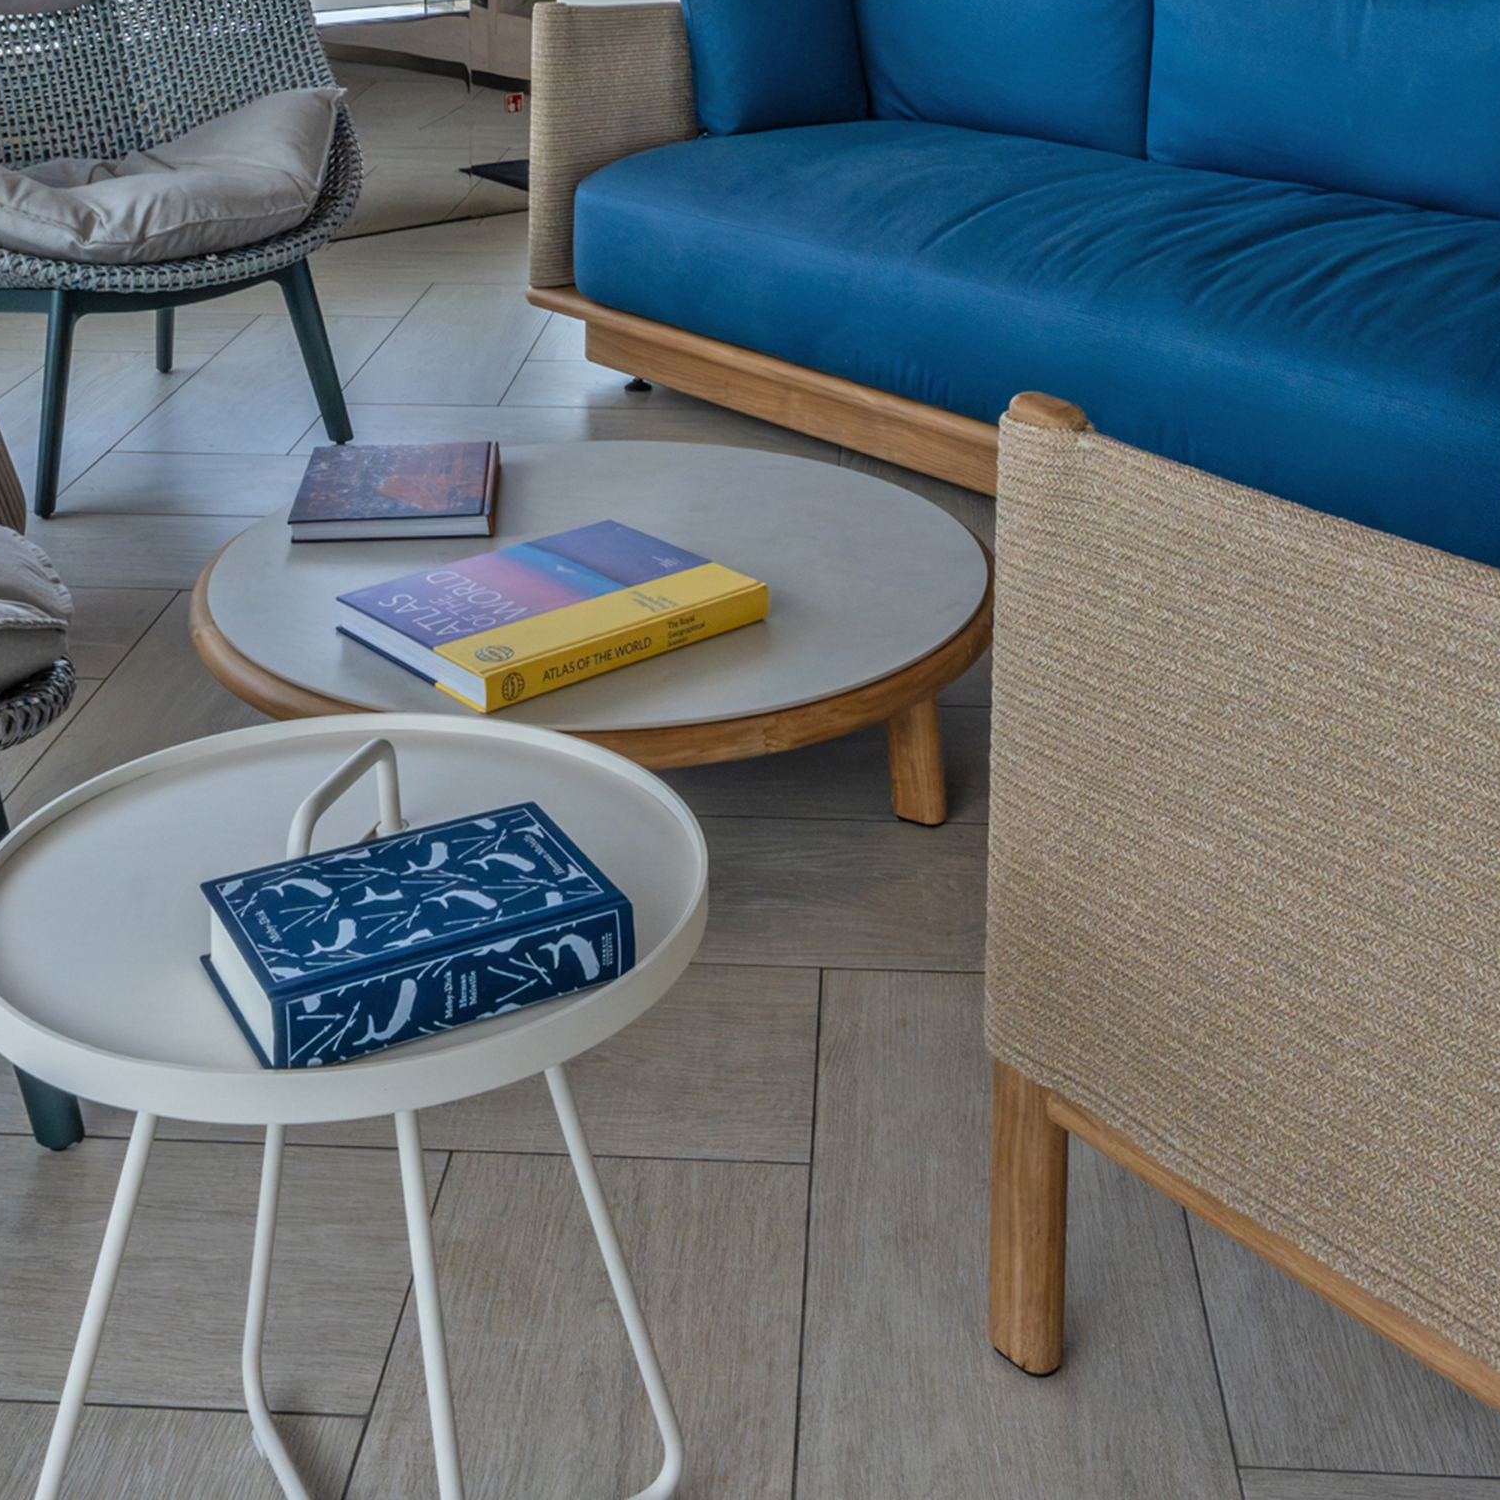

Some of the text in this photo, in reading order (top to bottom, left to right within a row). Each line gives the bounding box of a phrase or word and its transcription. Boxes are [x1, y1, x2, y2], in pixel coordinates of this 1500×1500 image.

[426, 570, 527, 621] WORLD
[428, 594, 496, 628] OF THE
[378, 594, 475, 636] ATLAS
[667, 614, 696, 629] The Royal
[542, 636, 652, 683] ATLAS OF THE WORLD
[254, 909, 282, 943] Moby-Dick
[443, 970, 455, 1019] Moby-Dick
[459, 973, 467, 1009] Herman
[468, 970, 478, 1006] Melville
